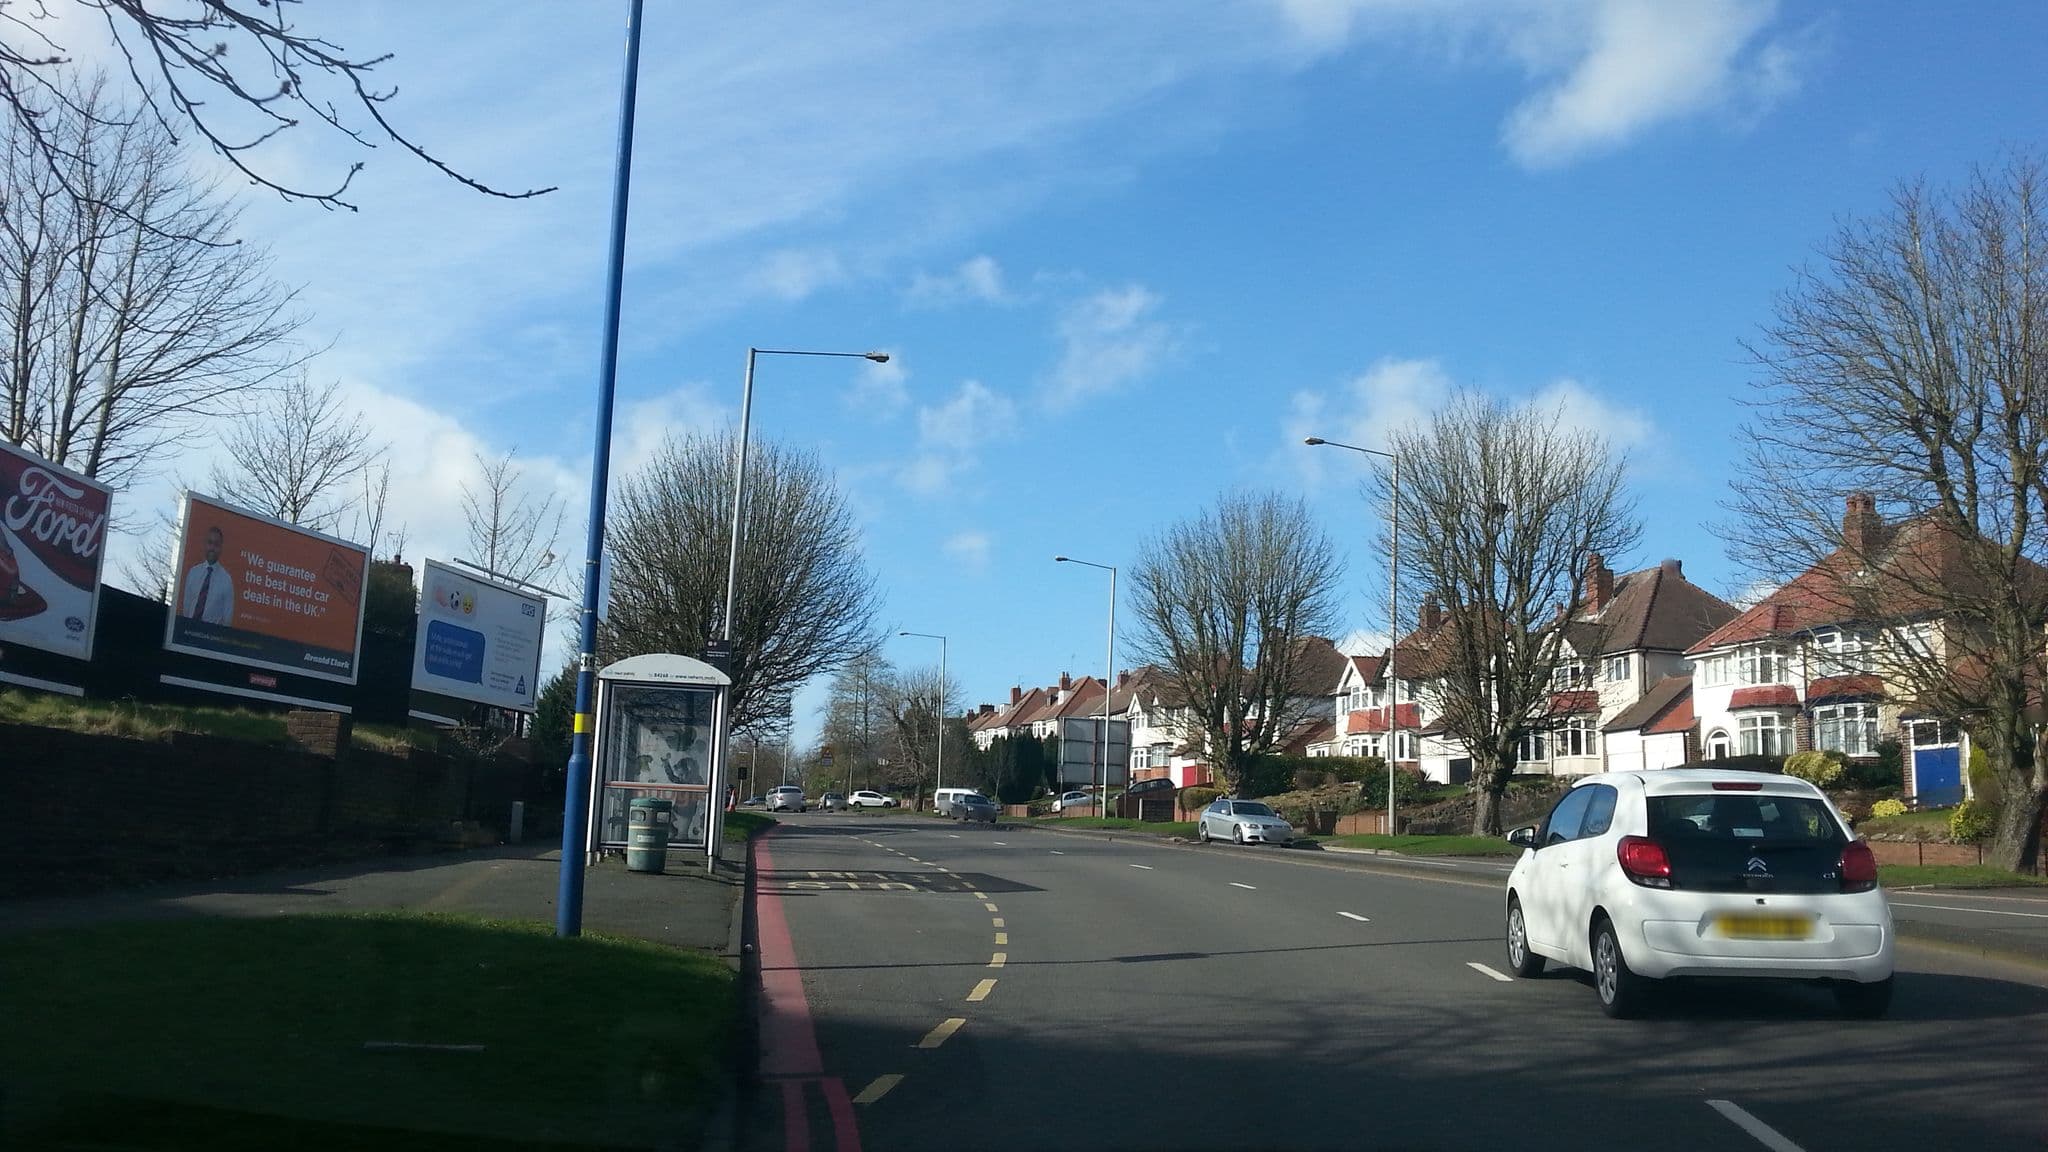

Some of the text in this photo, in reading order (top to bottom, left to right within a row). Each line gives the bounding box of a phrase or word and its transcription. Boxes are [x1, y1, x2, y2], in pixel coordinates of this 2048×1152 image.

[5, 466, 103, 557] Ford
[266, 561, 316, 583] guarantee
[245, 571, 329, 603] the best used car
[243, 588, 271, 606] deals
[273, 597, 283, 609] in
[285, 599, 301, 613] the
[521, 602, 536, 618] NHS
[303, 652, 350, 669] Arnold Clark
